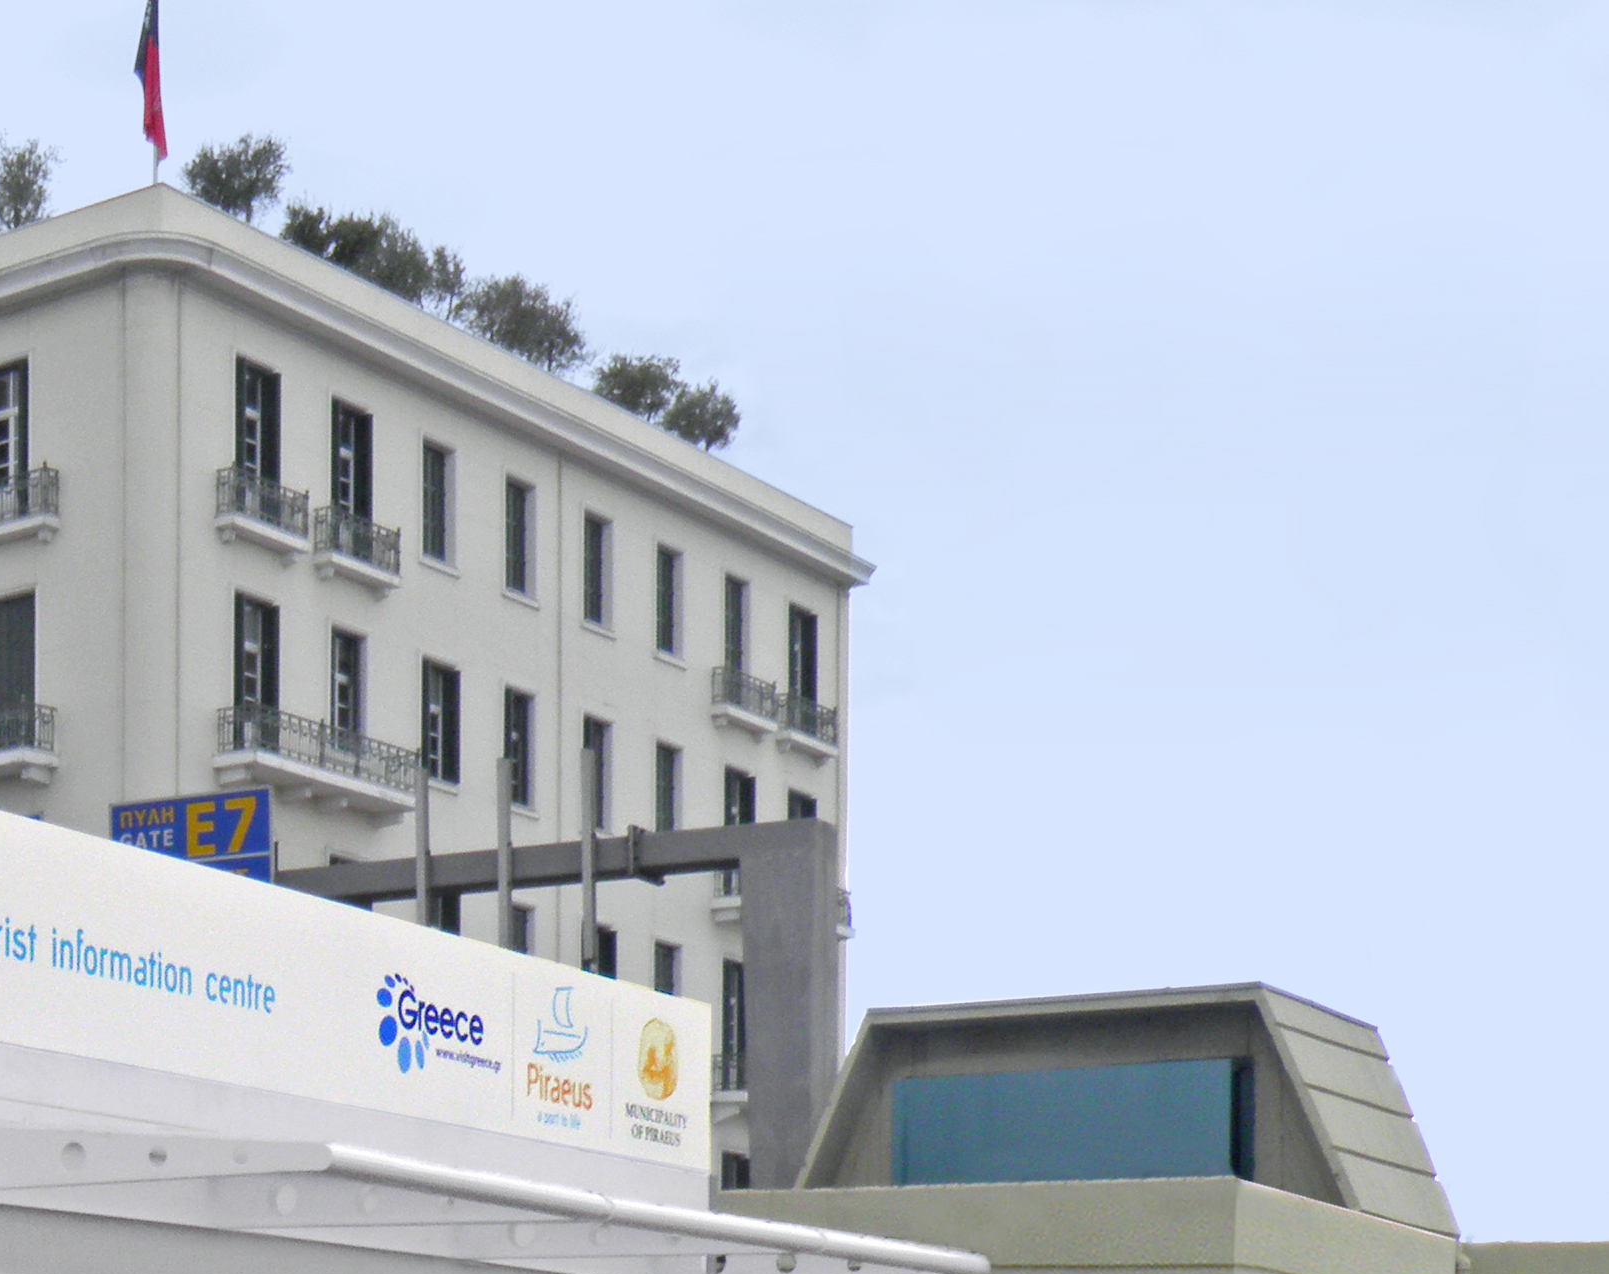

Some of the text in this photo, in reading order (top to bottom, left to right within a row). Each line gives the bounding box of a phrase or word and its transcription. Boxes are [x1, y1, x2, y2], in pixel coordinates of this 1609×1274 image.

[119, 806, 175, 829] ΠΥΛΗ
[186, 796, 256, 857] E7
[119, 828, 174, 850] GATE
[51, 927, 192, 996] information
[205, 971, 276, 1014] centre
[398, 989, 484, 1046] Greece
[527, 1062, 593, 1111] Piraeus
[625, 1102, 687, 1129] MUNICIPALITY
[631, 1123, 682, 1148] OF PIRAEUS
